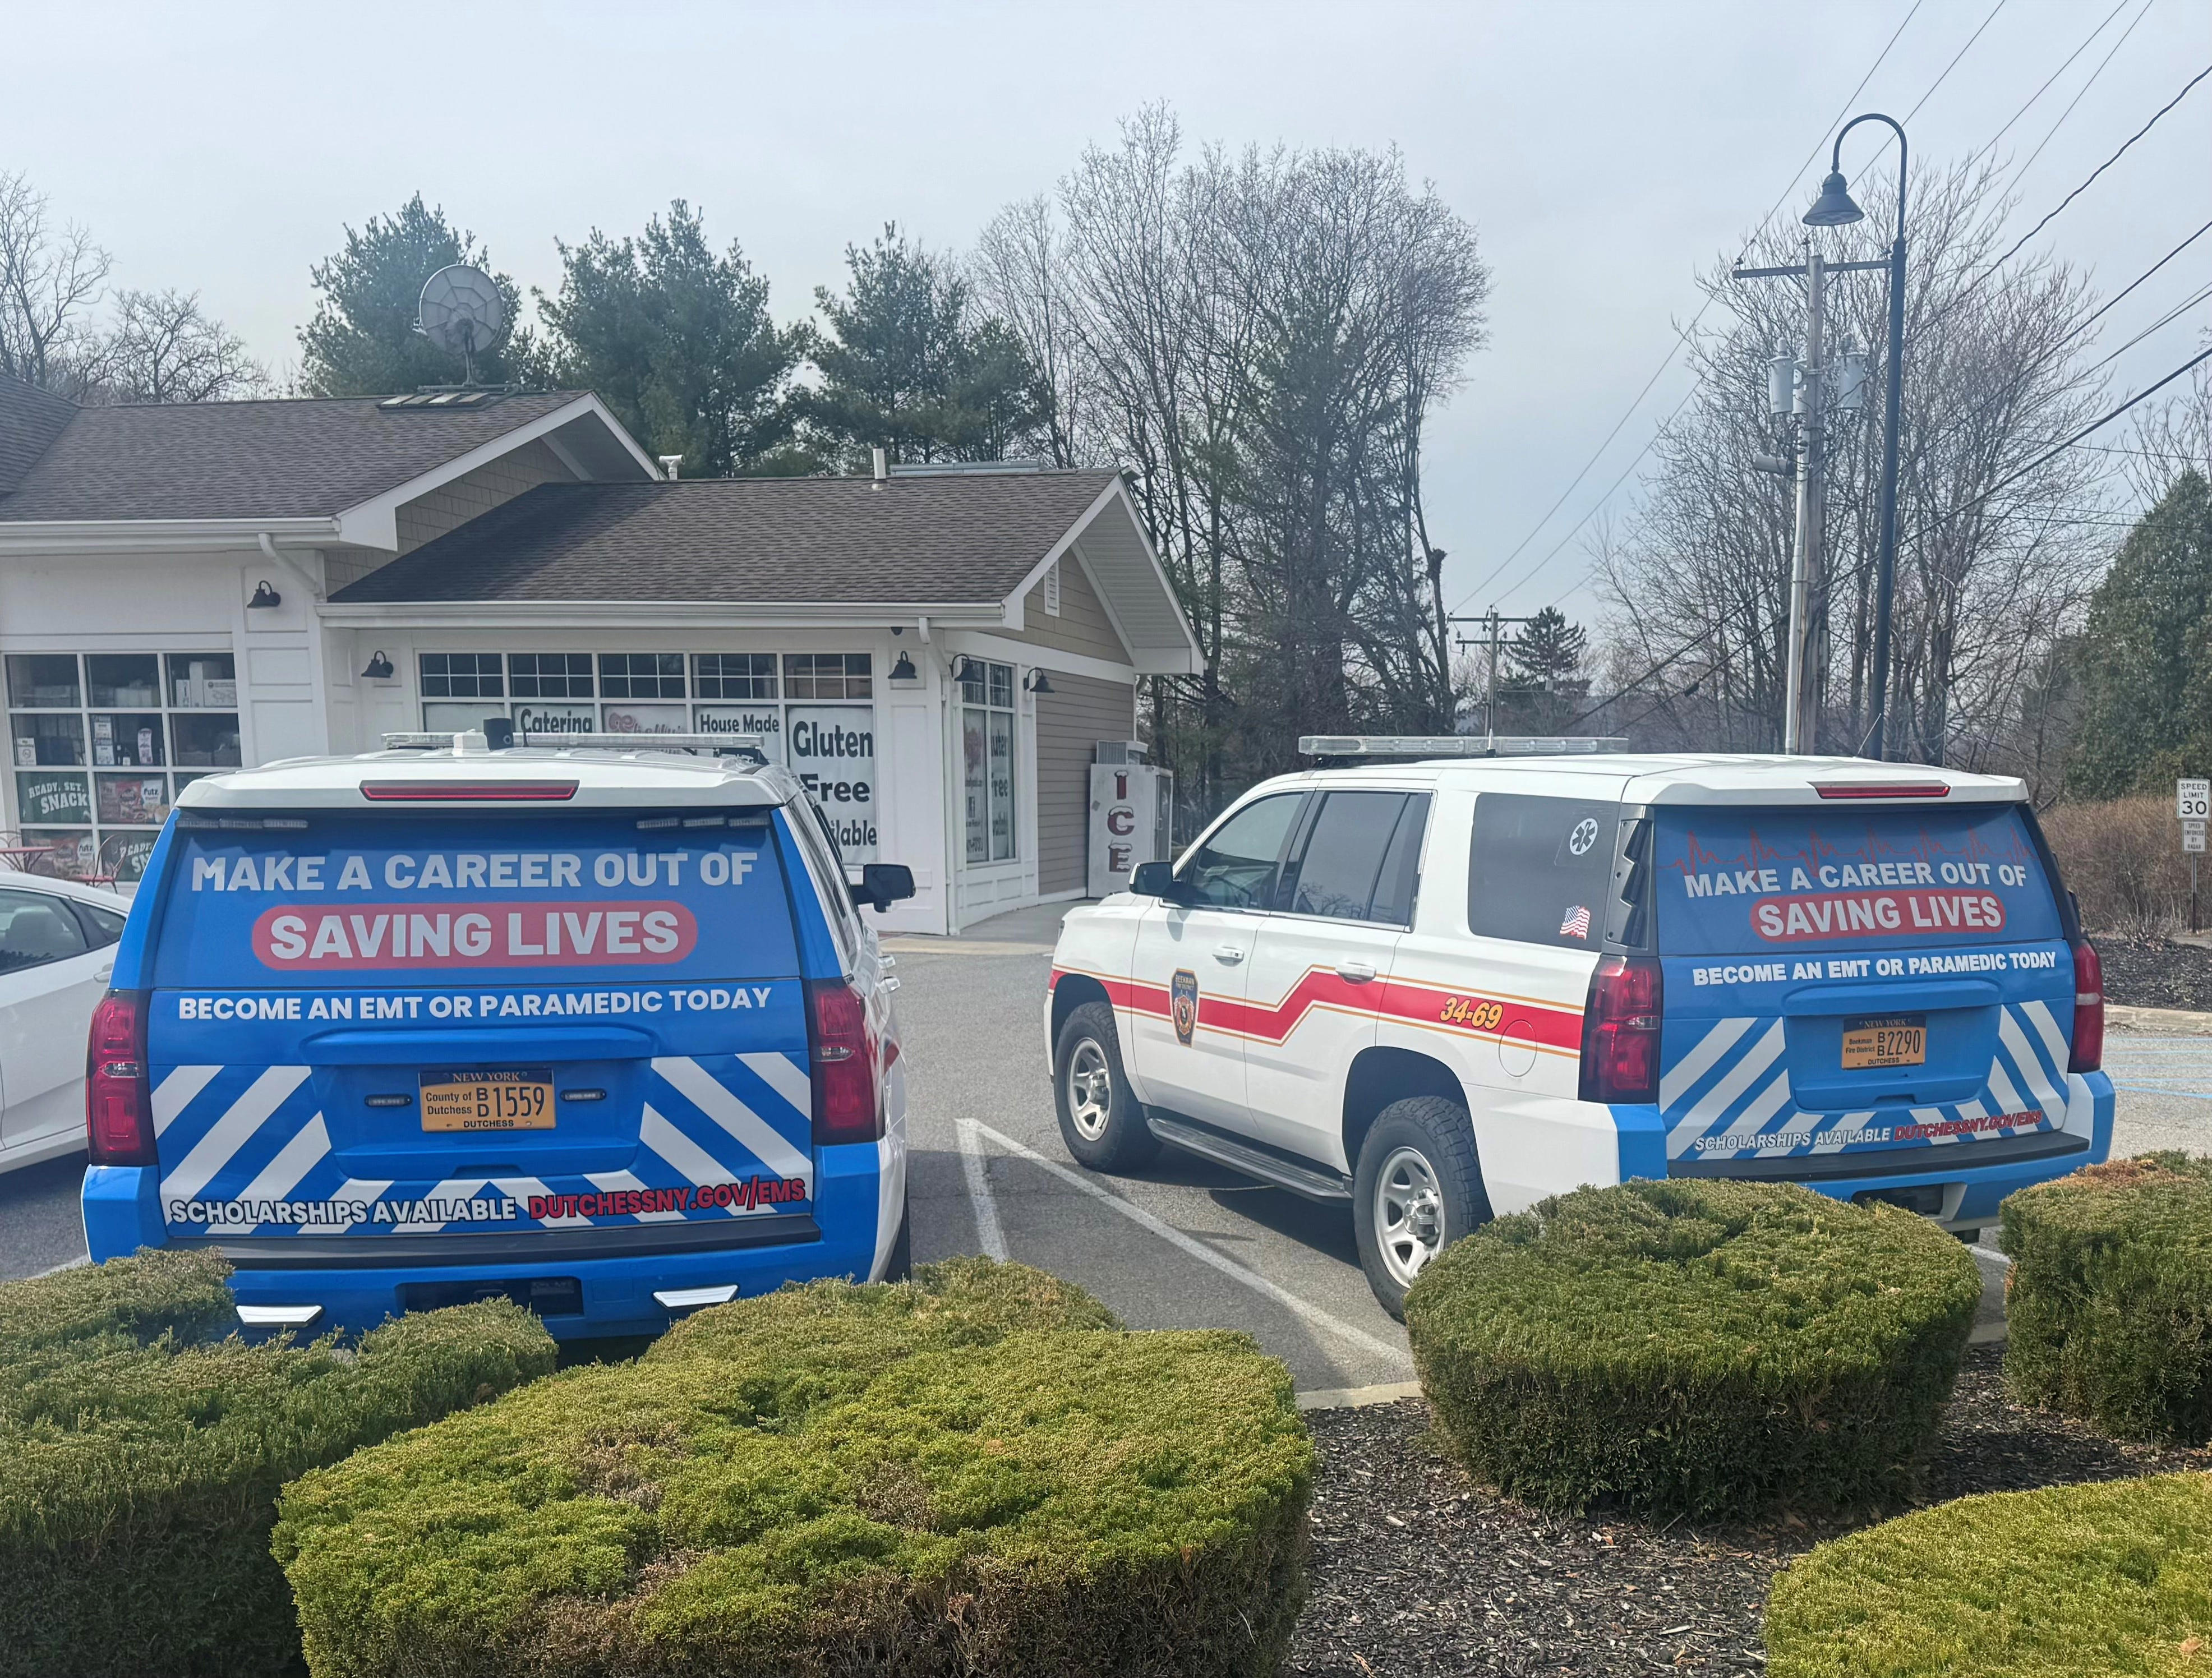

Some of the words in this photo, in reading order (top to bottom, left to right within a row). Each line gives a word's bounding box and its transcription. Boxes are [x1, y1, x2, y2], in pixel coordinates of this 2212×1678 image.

[701, 714, 739, 732] House
[743, 714, 779, 732] Made
[793, 721, 873, 757] Gluten
[1107, 770, 1135, 873] ICE
[2182, 801, 2206, 814] 30
[192, 856, 325, 891] MAKE
[337, 855, 372, 890] A
[385, 854, 582, 889] CAREER
[594, 852, 688, 887] OUT
[700, 852, 758, 886] OF
[1684, 869, 1781, 898] MAKE
[1791, 868, 1813, 890] A
[1819, 862, 1936, 888] CAREER
[1941, 862, 1990, 885] OUT
[1998, 864, 2026, 887] OF
[1758, 897, 1902, 937] SAVING
[1909, 896, 2002, 927] LIVES
[270, 914, 491, 960] SAVING
[508, 911, 679, 956] LIVES
[1693, 964, 1787, 986] BECOME
[1792, 961, 1822, 980] AN
[1827, 960, 1870, 978] EMT
[1875, 958, 1905, 976] OR
[1909, 953, 2007, 975] PARAMEDIC
[2010, 952, 2056, 969] TODAY
[179, 998, 301, 1020] BECOME
[307, 998, 352, 1019] AN
[360, 996, 422, 1018] EMT
[428, 995, 472, 1018] OR
[480, 990, 663, 1017] PARAMEDIC
[669, 987, 772, 1011] TODAY
[1439, 997, 1504, 1030] 34-69
[1864, 1020, 1885, 1029] NEW
[1886, 1018, 1907, 1027] YORK
[1887, 1030, 1920, 1056] 2290
[453, 1072, 484, 1082] NEW
[486, 1072, 519, 1081] YORK
[426, 1092, 459, 1103] County
[463, 1091, 472, 1101] of
[427, 1106, 472, 1115] Dutchess
[493, 1086, 545, 1117] 1559
[463, 1120, 514, 1128] DUTCHESS
[1695, 1131, 1811, 1151] SCHOLARSHIPS
[1814, 1127, 1891, 1146] AVAILABLE
[170, 1200, 368, 1225] SCHOLARSHIPS
[372, 1196, 517, 1224] AVAILABLE
[528, 1175, 806, 1220] DUTCHESSNY.GOV/EMS
